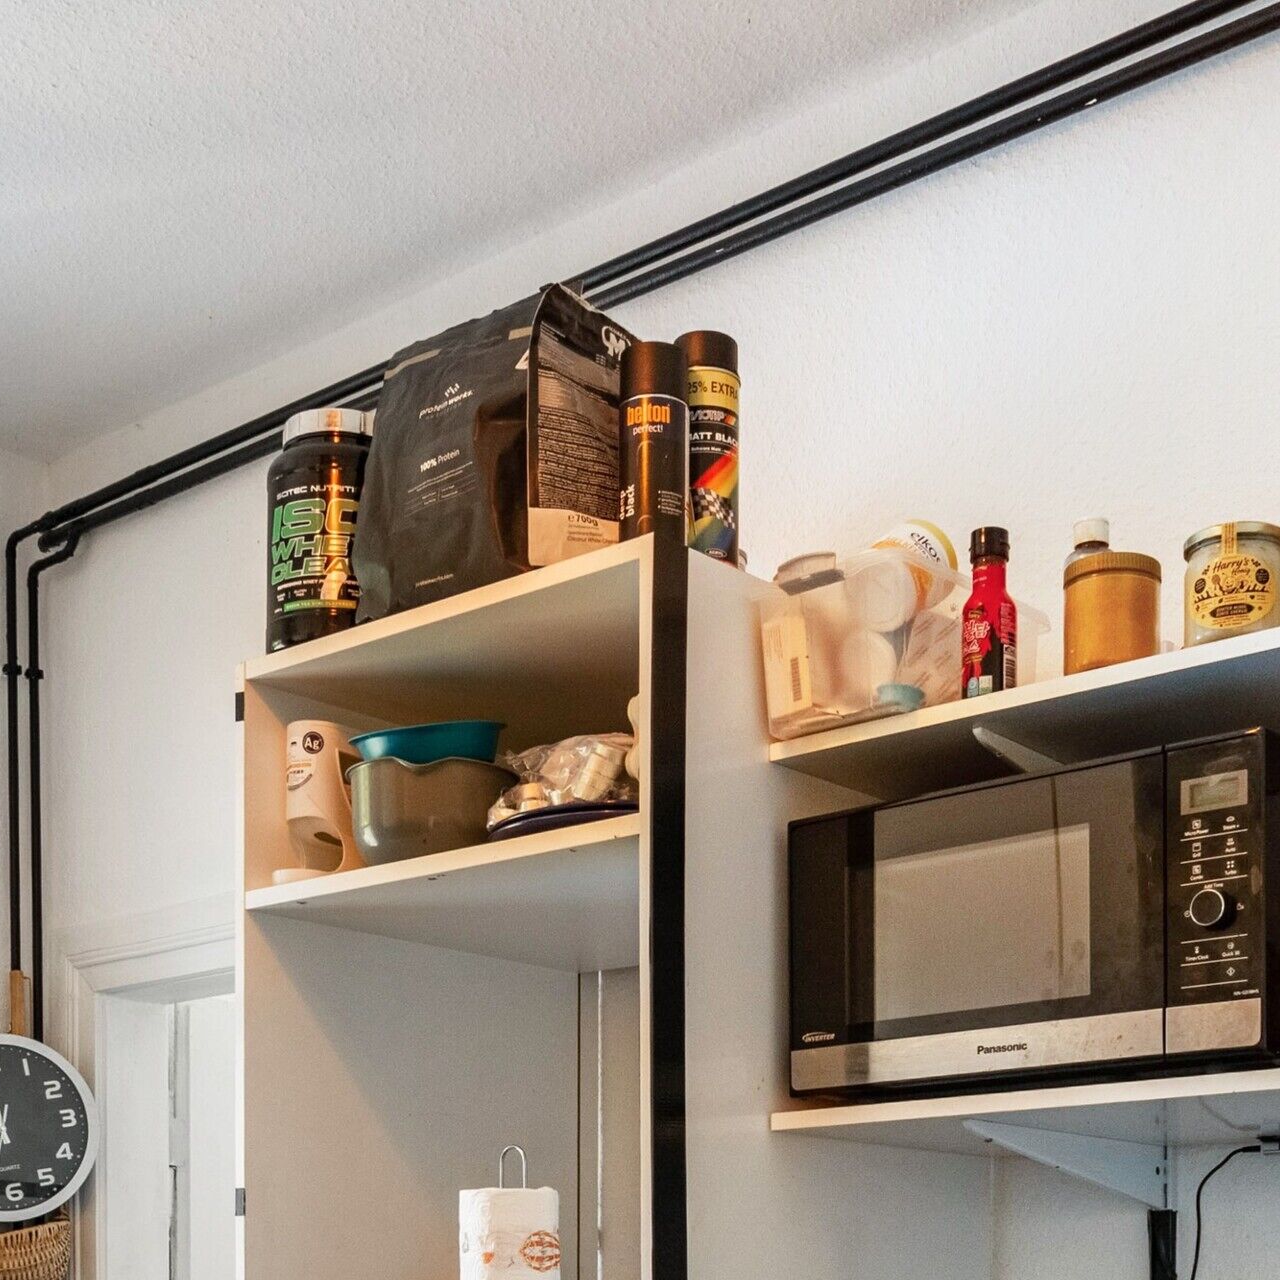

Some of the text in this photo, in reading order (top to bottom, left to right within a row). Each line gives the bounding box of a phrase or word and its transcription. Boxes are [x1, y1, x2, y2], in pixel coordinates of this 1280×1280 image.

[627, 404, 670, 426] belton
[632, 422, 664, 436] perfect!
[420, 449, 460, 473] 100% Protein
[310, 484, 357, 494] NUTRITI
[625, 484, 635, 517] black
[271, 535, 351, 564] WHE
[271, 557, 352, 586] CLEA
[1213, 557, 1249, 574] Harry's
[805, 1032, 836, 1043] INVERTER
[977, 1042, 1028, 1055] Panasonic
[22, 1058, 31, 1077] 1
[43, 1080, 63, 1100] 2
[59, 1108, 78, 1128] 3
[55, 1142, 74, 1160] 4
[37, 1168, 56, 1187] 5
[5, 1183, 24, 1202] 6
